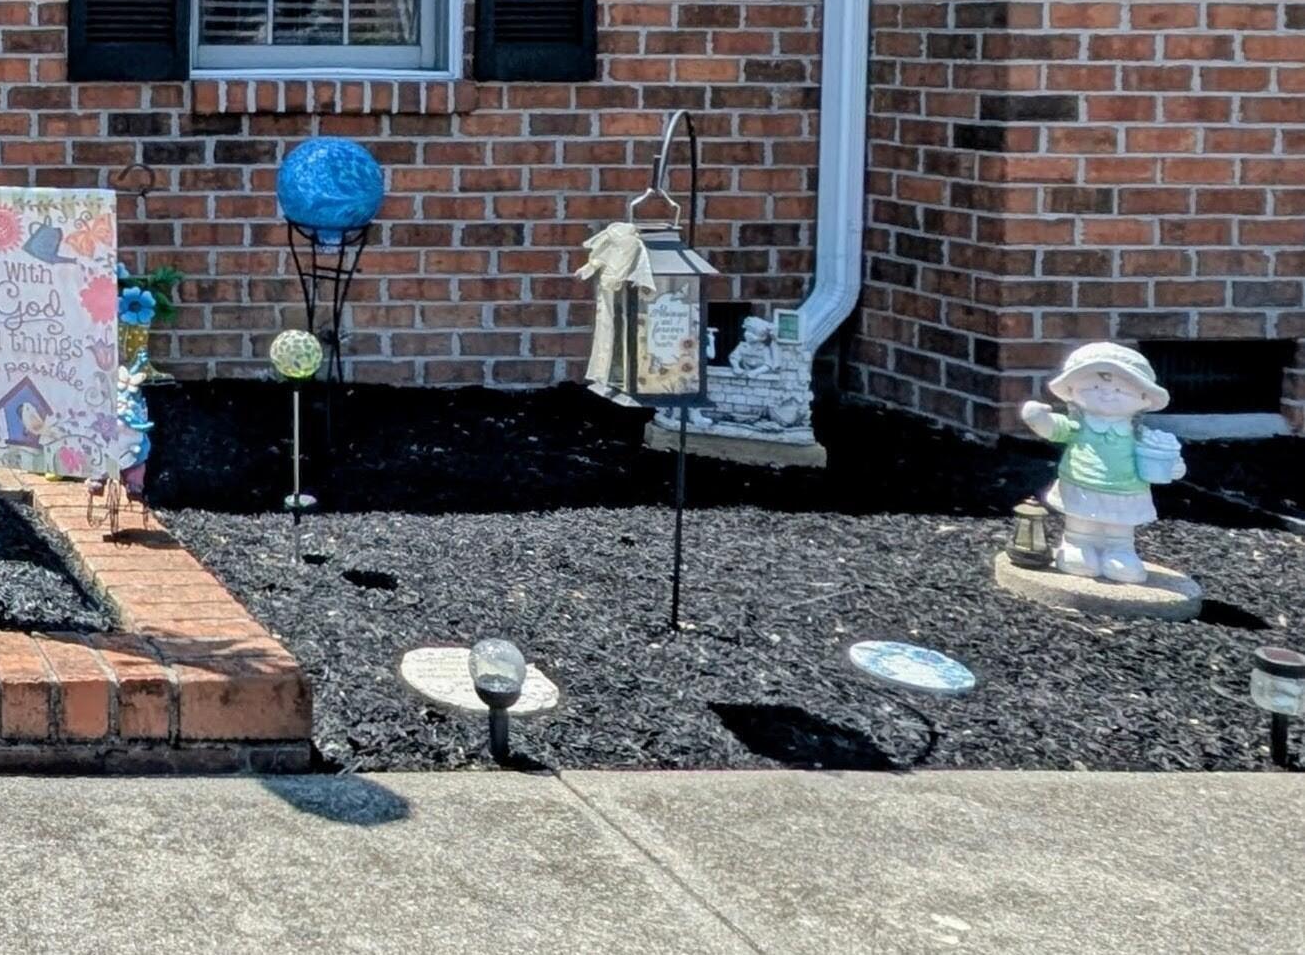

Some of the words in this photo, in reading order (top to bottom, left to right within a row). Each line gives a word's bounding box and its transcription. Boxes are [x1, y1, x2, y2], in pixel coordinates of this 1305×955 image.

[3, 260, 53, 286] With
[8, 330, 83, 361] things
[4, 359, 84, 391] possible
